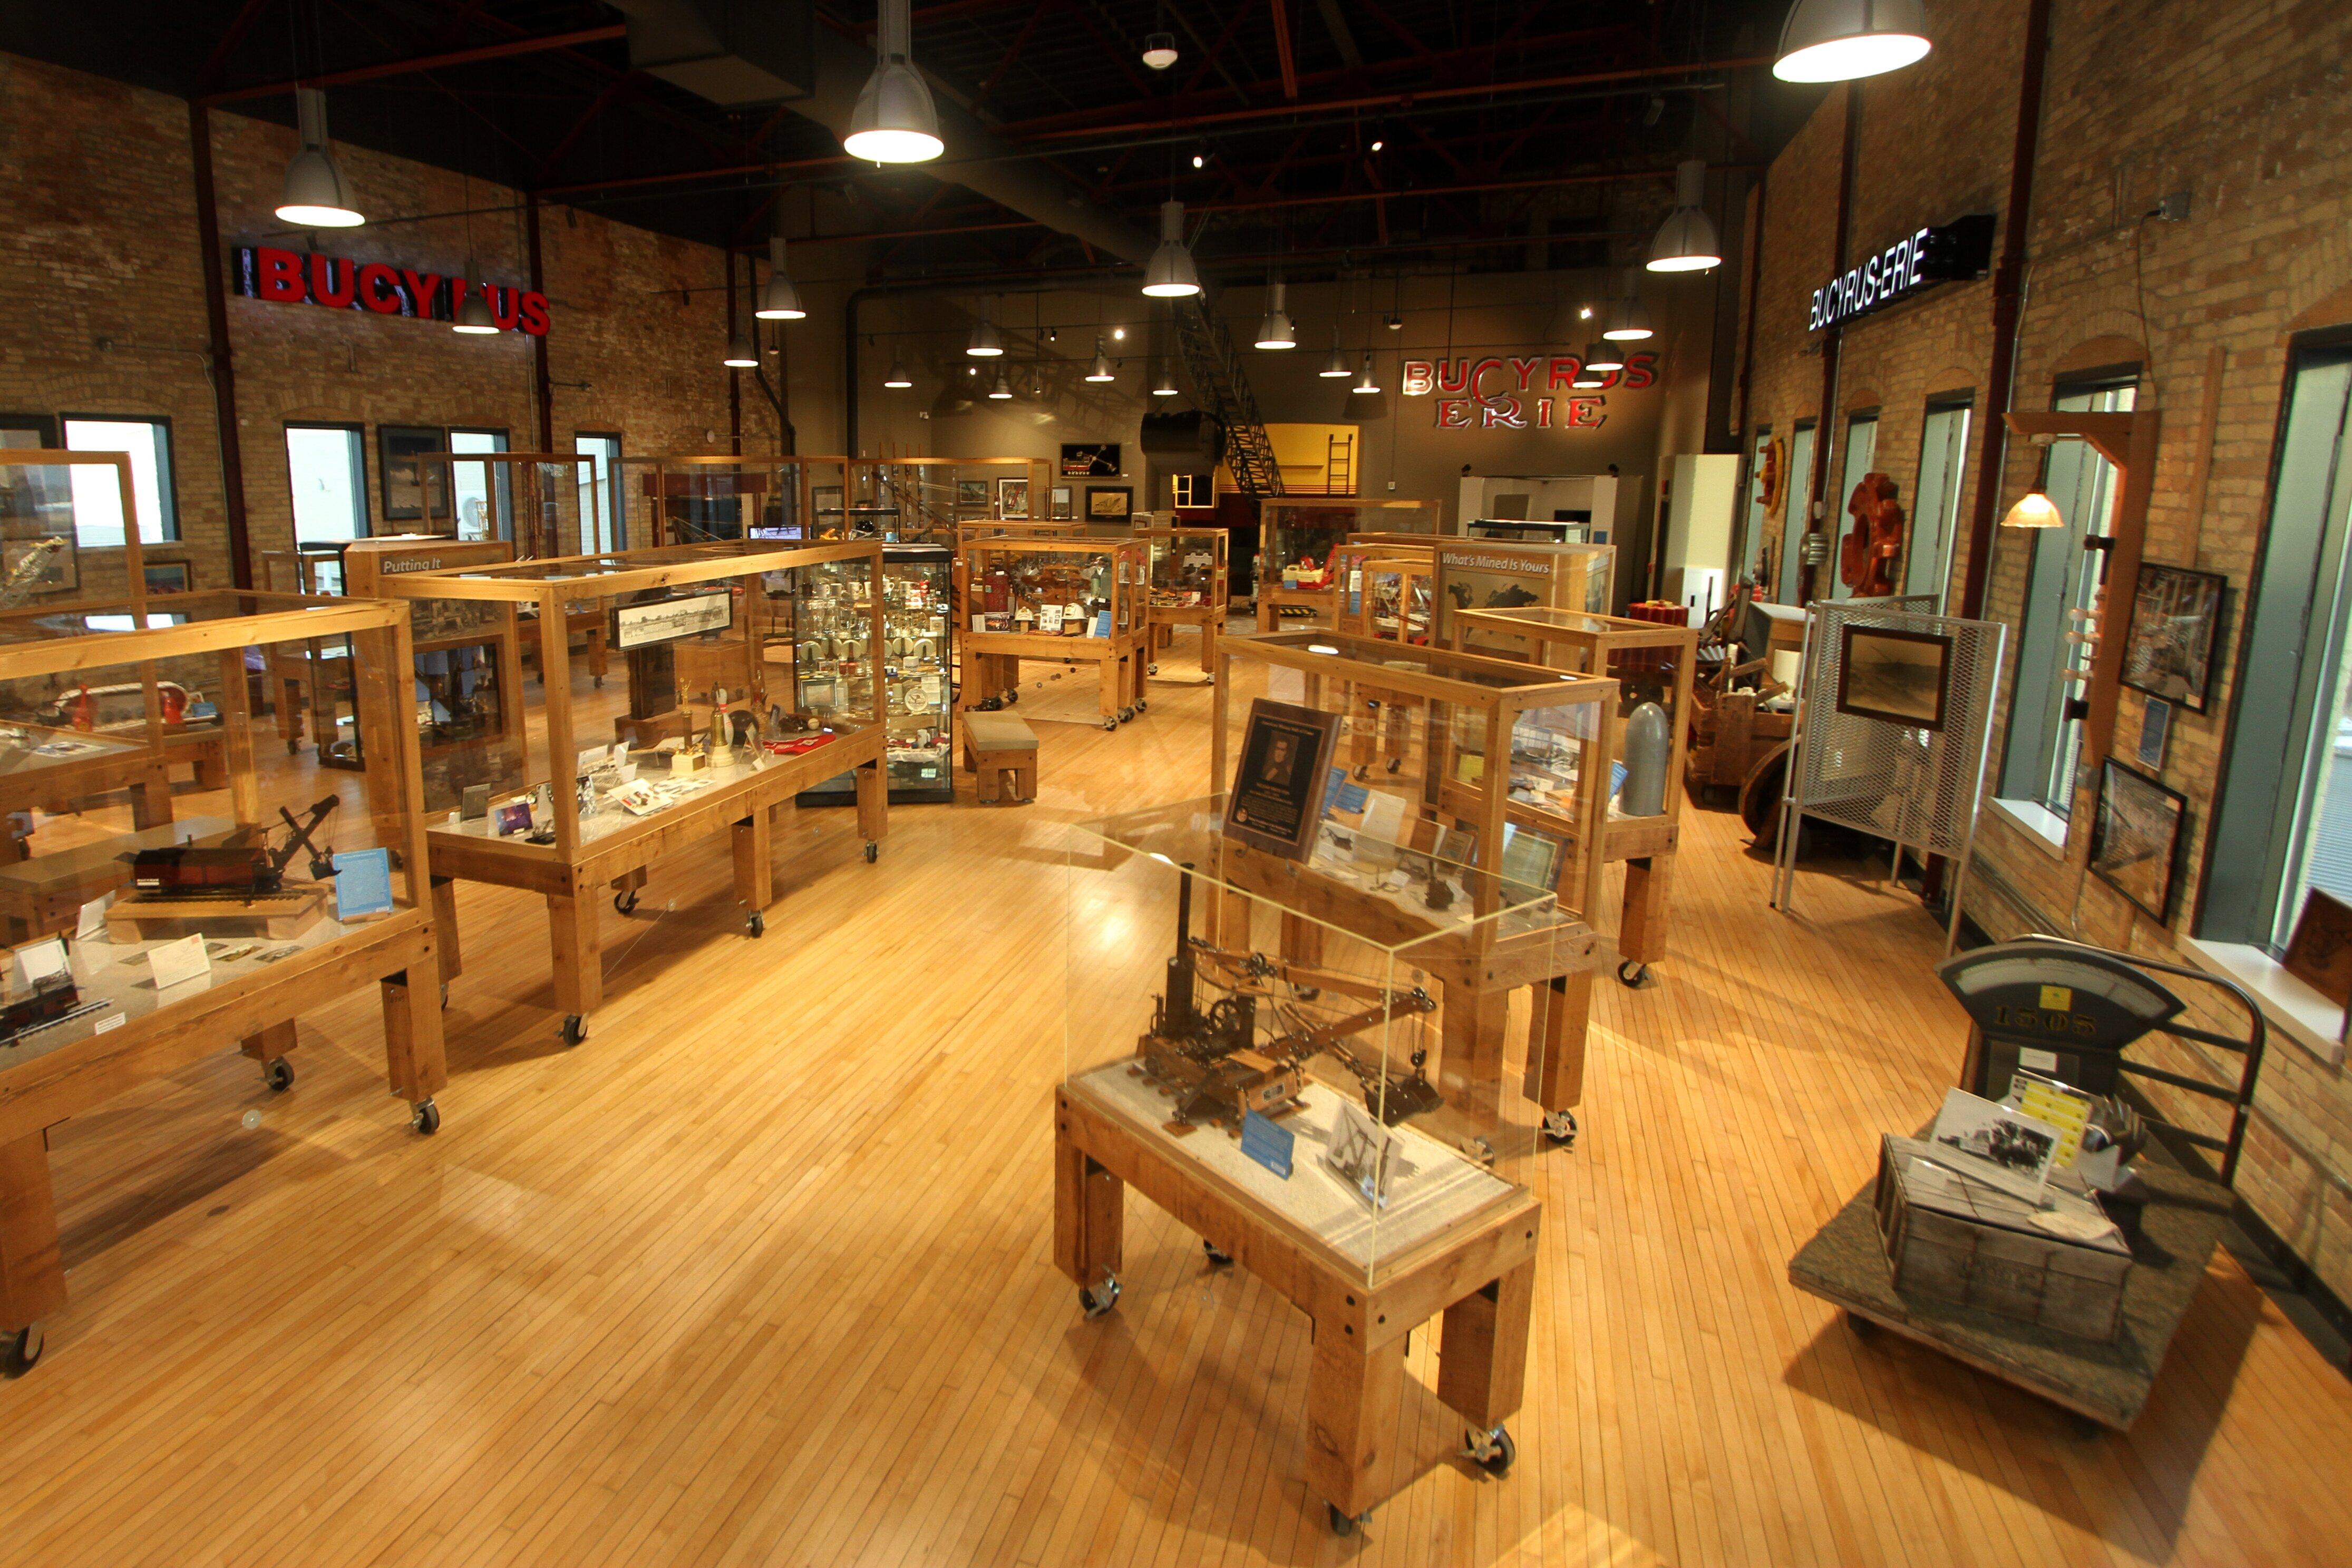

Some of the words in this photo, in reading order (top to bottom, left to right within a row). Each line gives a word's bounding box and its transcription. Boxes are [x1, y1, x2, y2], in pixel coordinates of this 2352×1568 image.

[1809, 227, 1930, 332] BUCYRUS-ERIE
[1436, 395, 1606, 429] ERIE
[383, 559, 430, 573] Putting
[432, 557, 441, 569] It
[1442, 552, 1475, 566] What's
[1475, 555, 1508, 570] Mined
[1509, 558, 1518, 571] Is
[1520, 559, 1550, 574] Yours
